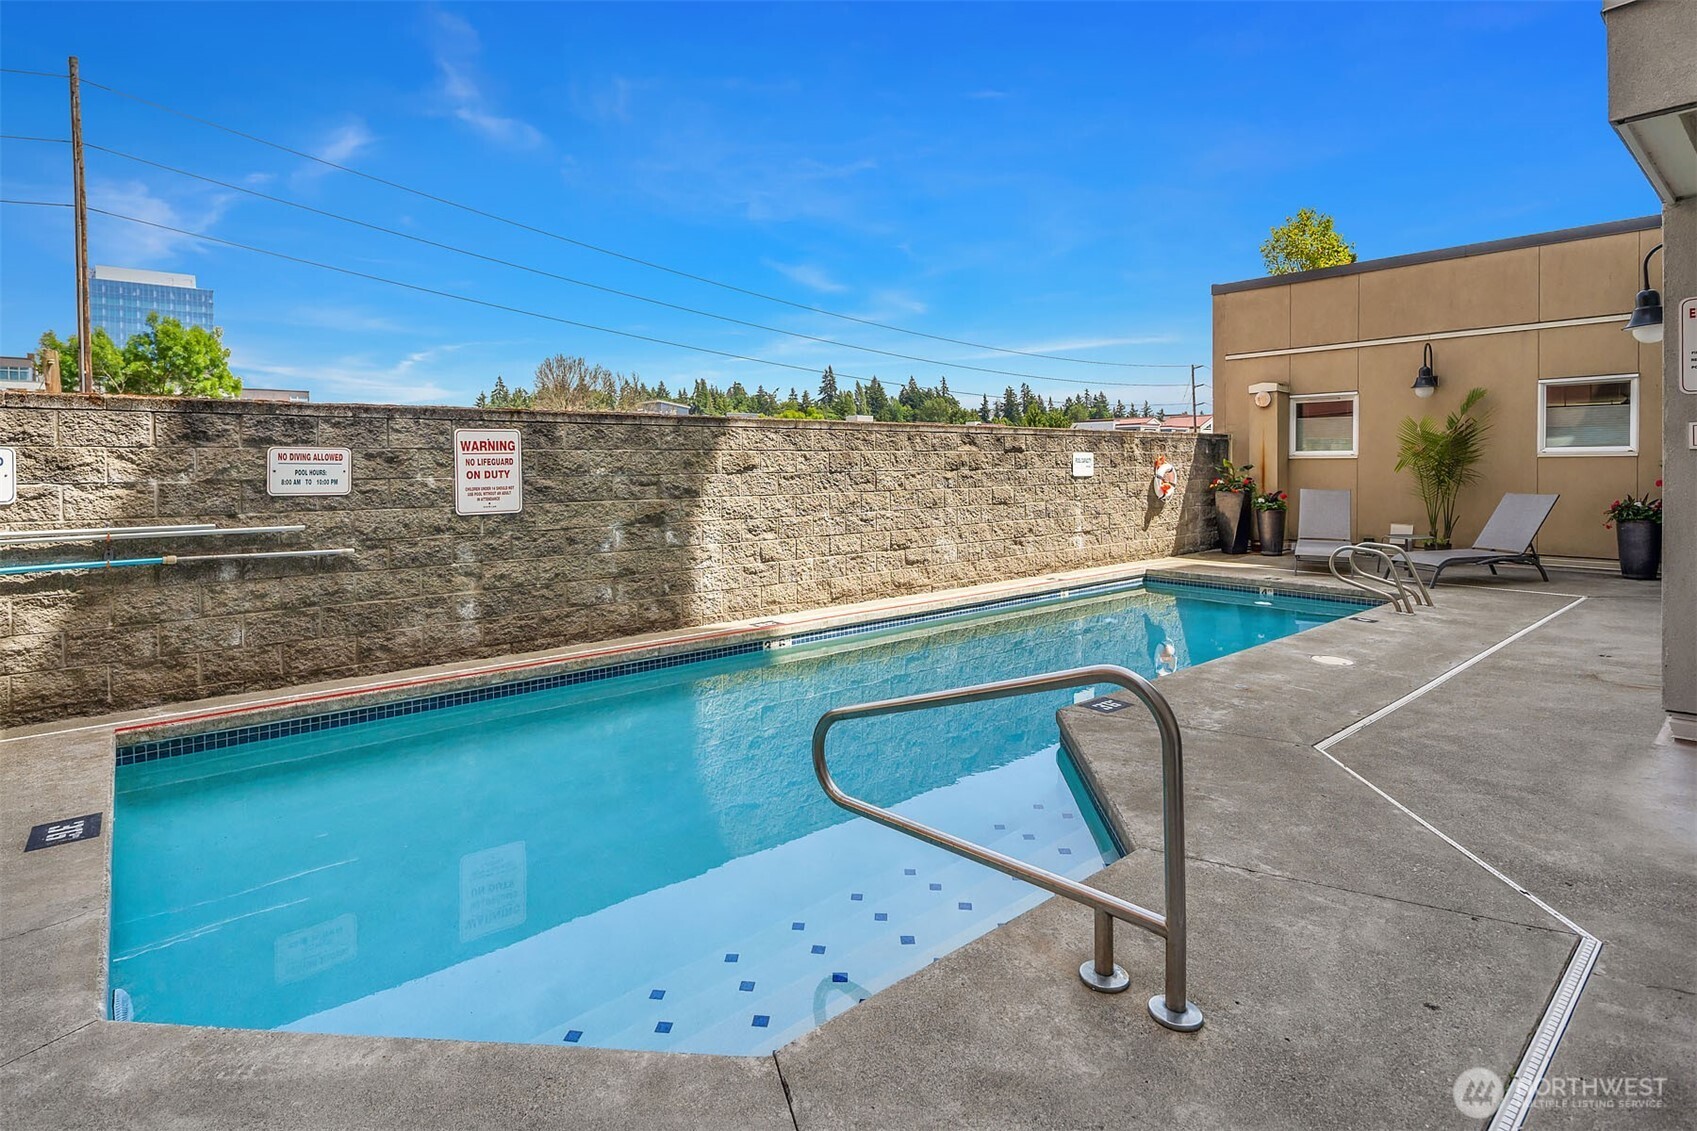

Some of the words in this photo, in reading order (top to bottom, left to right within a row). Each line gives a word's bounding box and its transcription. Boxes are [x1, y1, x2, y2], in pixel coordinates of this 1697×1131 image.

[460, 440, 516, 452] WARNING
[277, 452, 288, 461] NO
[289, 452, 312, 461] DIVING
[312, 453, 344, 462] ALLOWED
[465, 458, 475, 467] NO
[477, 457, 514, 466] LIFEGUARD
[466, 470, 481, 480] ON
[484, 469, 511, 479] DUTY
[281, 478, 292, 486] 8:00
[292, 478, 301, 486] AM
[316, 478, 329, 486] 10:00
[330, 478, 339, 486] PM
